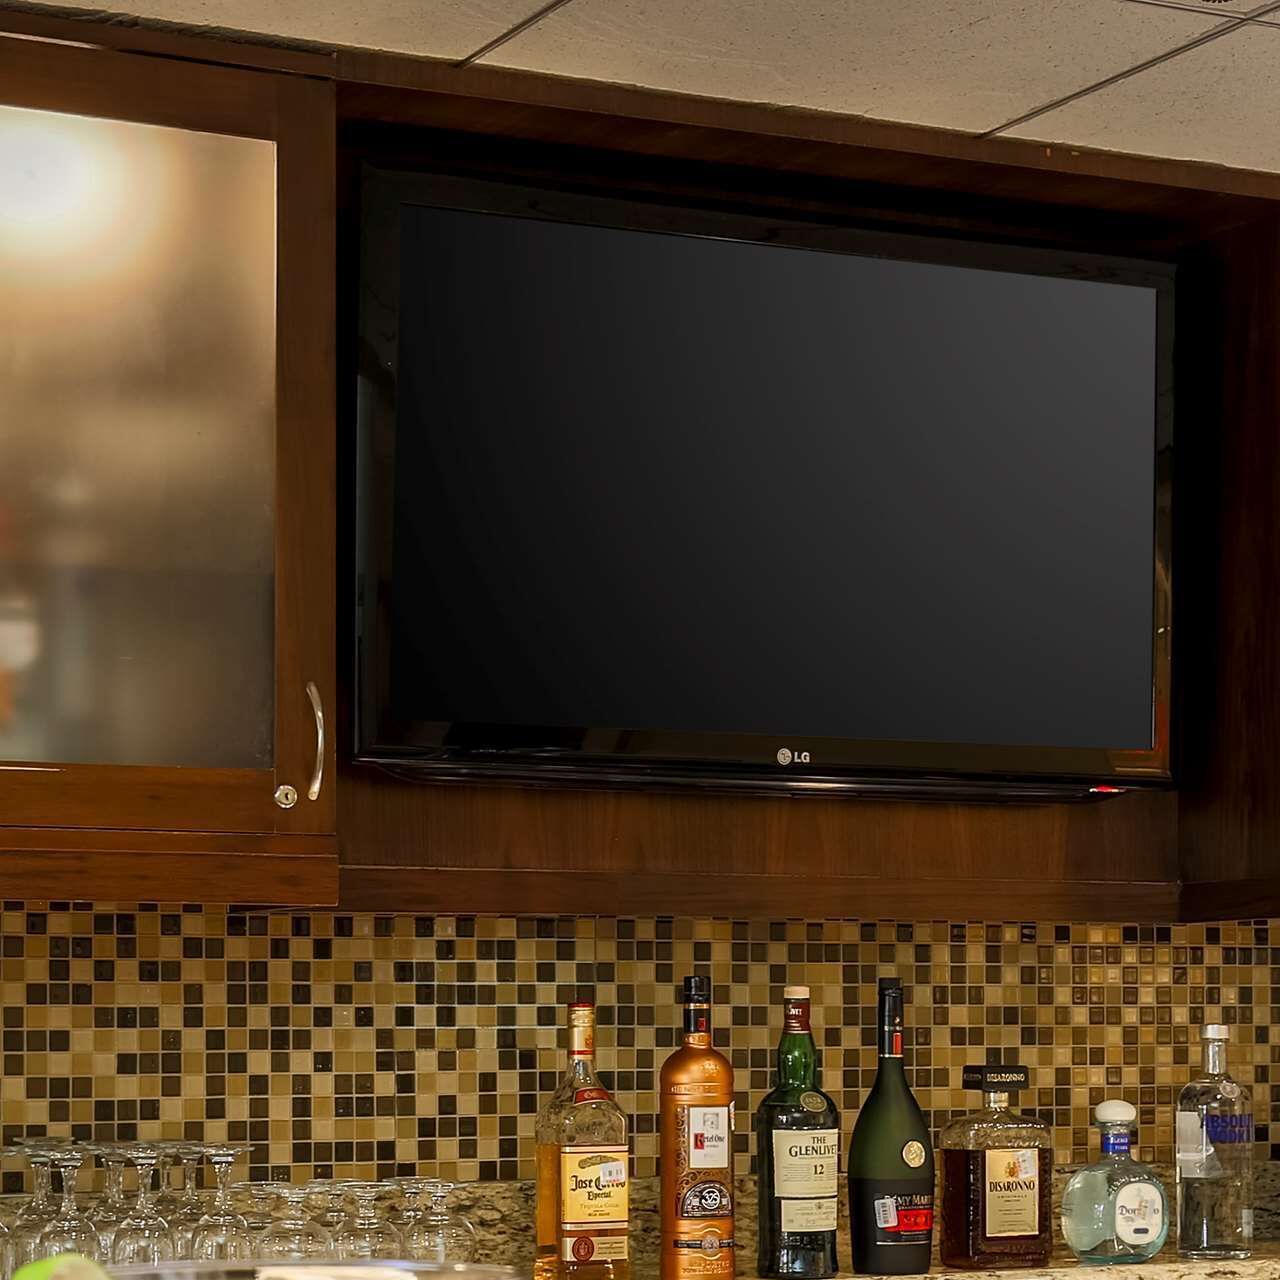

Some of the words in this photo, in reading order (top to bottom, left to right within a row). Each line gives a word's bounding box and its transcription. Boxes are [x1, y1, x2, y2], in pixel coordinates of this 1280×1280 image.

[794, 751, 810, 763] LG
[811, 1136, 827, 1144] THE
[813, 1164, 825, 1175] 12
[570, 1174, 594, 1192] Jose
[989, 1180, 1035, 1193] DISARONNO
